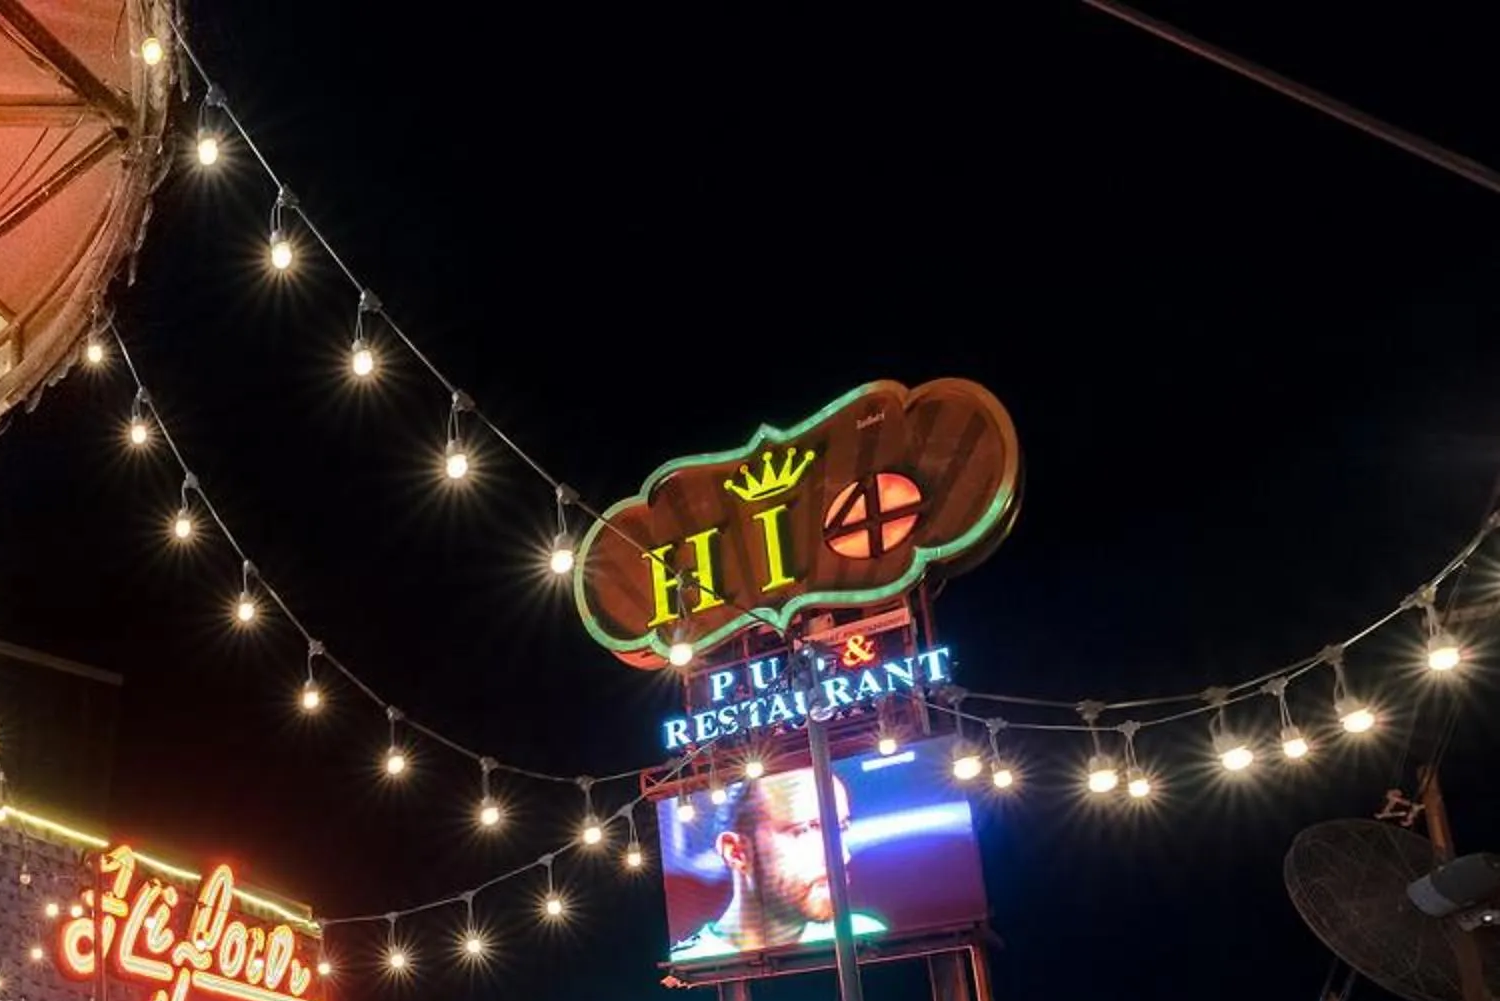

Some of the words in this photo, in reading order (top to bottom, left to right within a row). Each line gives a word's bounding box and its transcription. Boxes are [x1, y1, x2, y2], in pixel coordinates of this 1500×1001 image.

[641, 504, 795, 628] HI
[709, 650, 826, 702] PU
[843, 635, 876, 667] &
